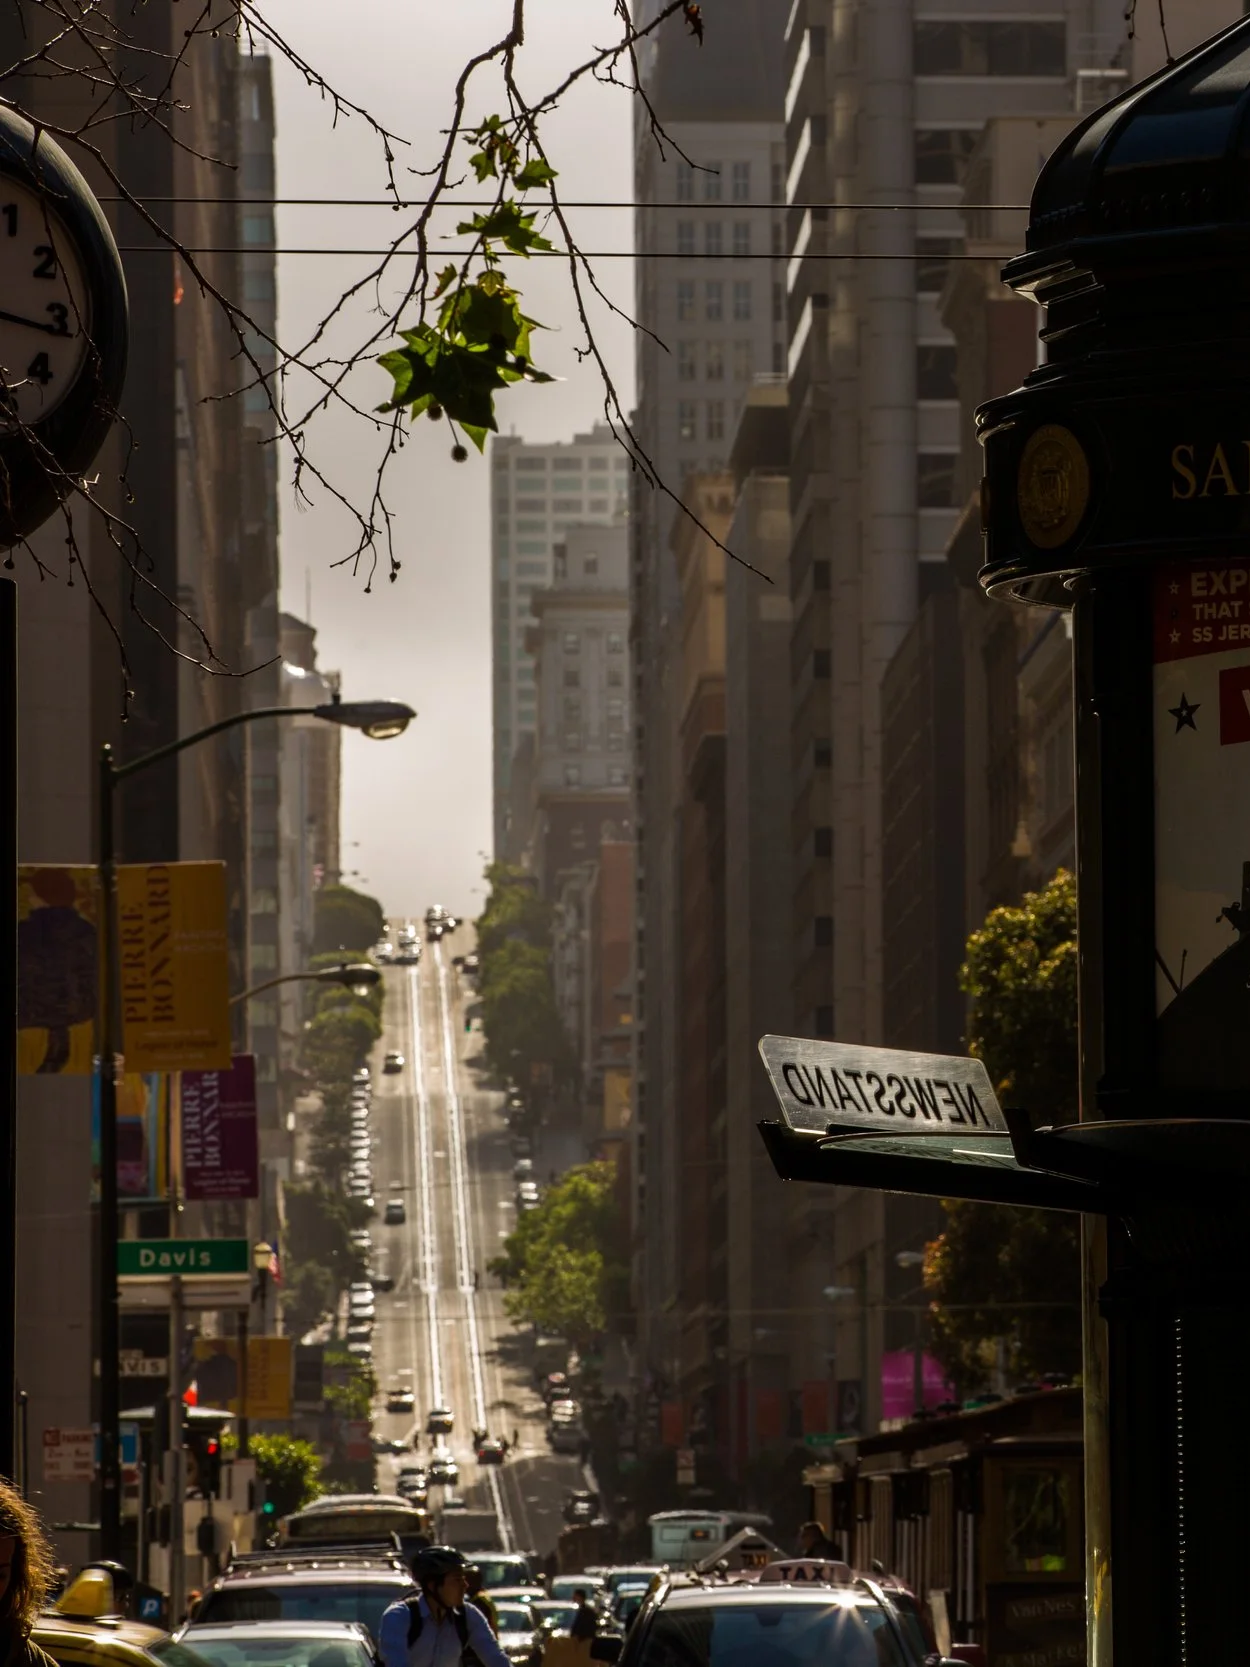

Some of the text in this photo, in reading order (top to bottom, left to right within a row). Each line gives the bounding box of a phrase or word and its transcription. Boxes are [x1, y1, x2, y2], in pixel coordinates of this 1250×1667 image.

[3, 203, 18, 237] 1
[33, 246, 57, 279] 2
[46, 303, 68, 335] 3
[28, 352, 53, 385] 4
[1192, 600, 1243, 621] THAT
[1192, 627, 1213, 643] SS
[147, 866, 175, 1023] BONNARD
[121, 901, 148, 1023] PIERRE
[183, 1082, 202, 1167] PIERRE
[201, 1071, 220, 1167] BONNAR
[139, 1247, 212, 1268] Davis
[741, 1553, 769, 1568] TAXI
[779, 1566, 836, 1581] TAXI
